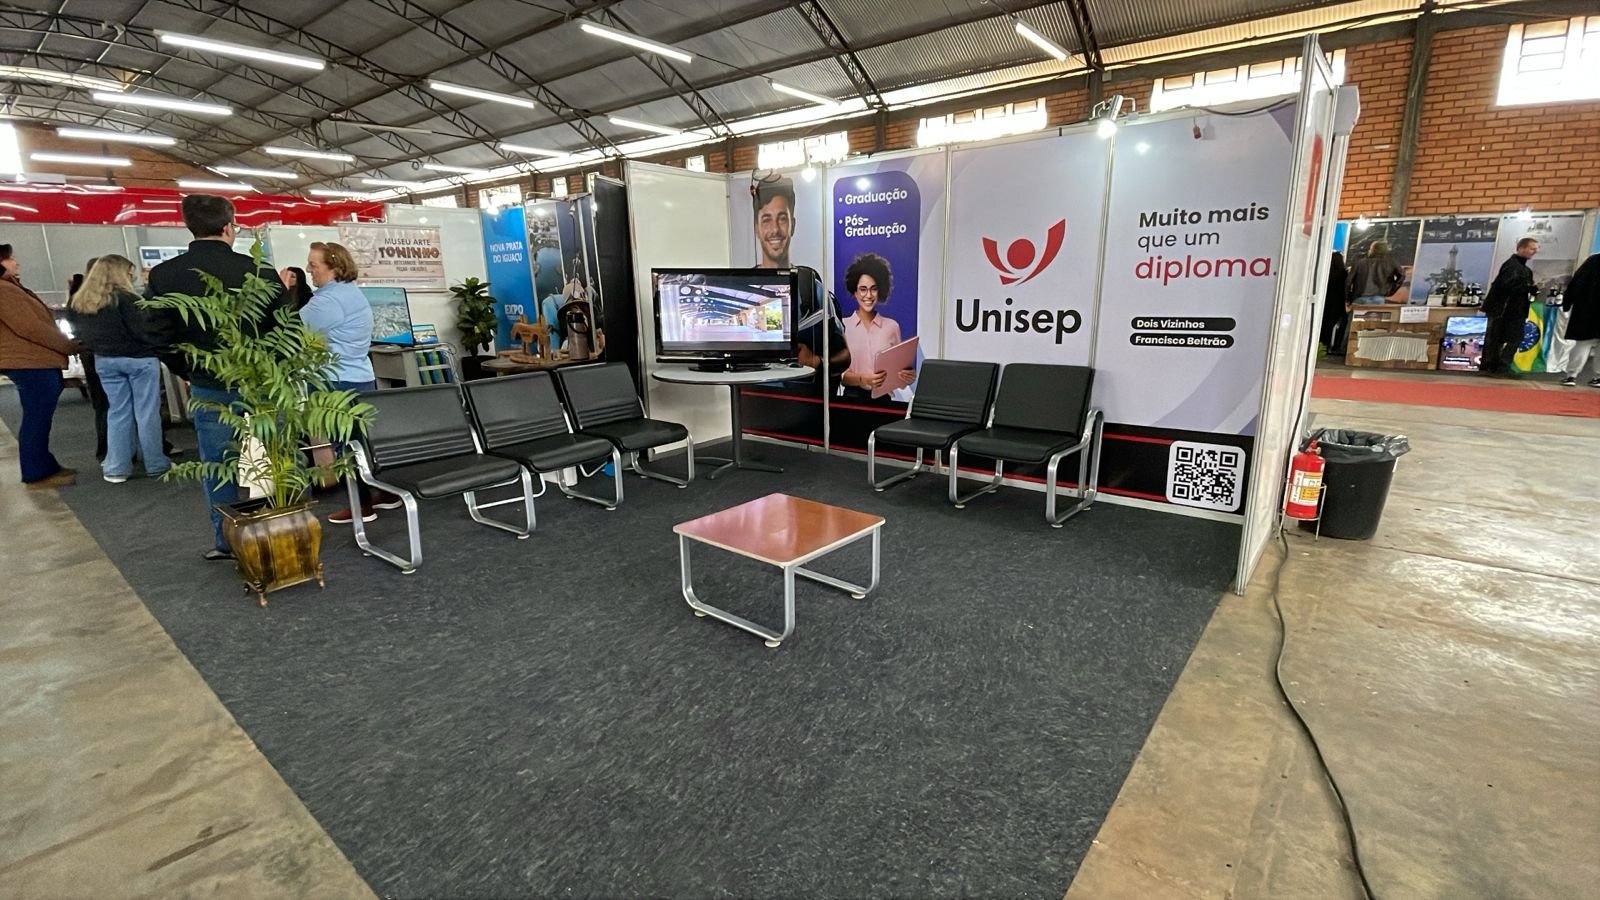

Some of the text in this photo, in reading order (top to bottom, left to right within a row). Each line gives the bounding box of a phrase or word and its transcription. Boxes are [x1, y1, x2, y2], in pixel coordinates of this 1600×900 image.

[845, 188, 908, 205] Graduação
[845, 214, 869, 226] Pós-
[1139, 202, 1270, 228] Muito mais
[845, 222, 907, 238] Graduação
[384, 238, 431, 246] MUSEU ARTE
[490, 241, 523, 252] NOVA PRATA
[1137, 231, 1220, 253] que um
[493, 252, 523, 263] DO IGUAÇU
[1135, 255, 1277, 286] diploma.
[504, 304, 524, 315] EXPO
[955, 297, 1082, 344] Unisep
[1136, 319, 1205, 329] Dois Vizinhos
[1135, 335, 1227, 346] Francisco Beltrão
